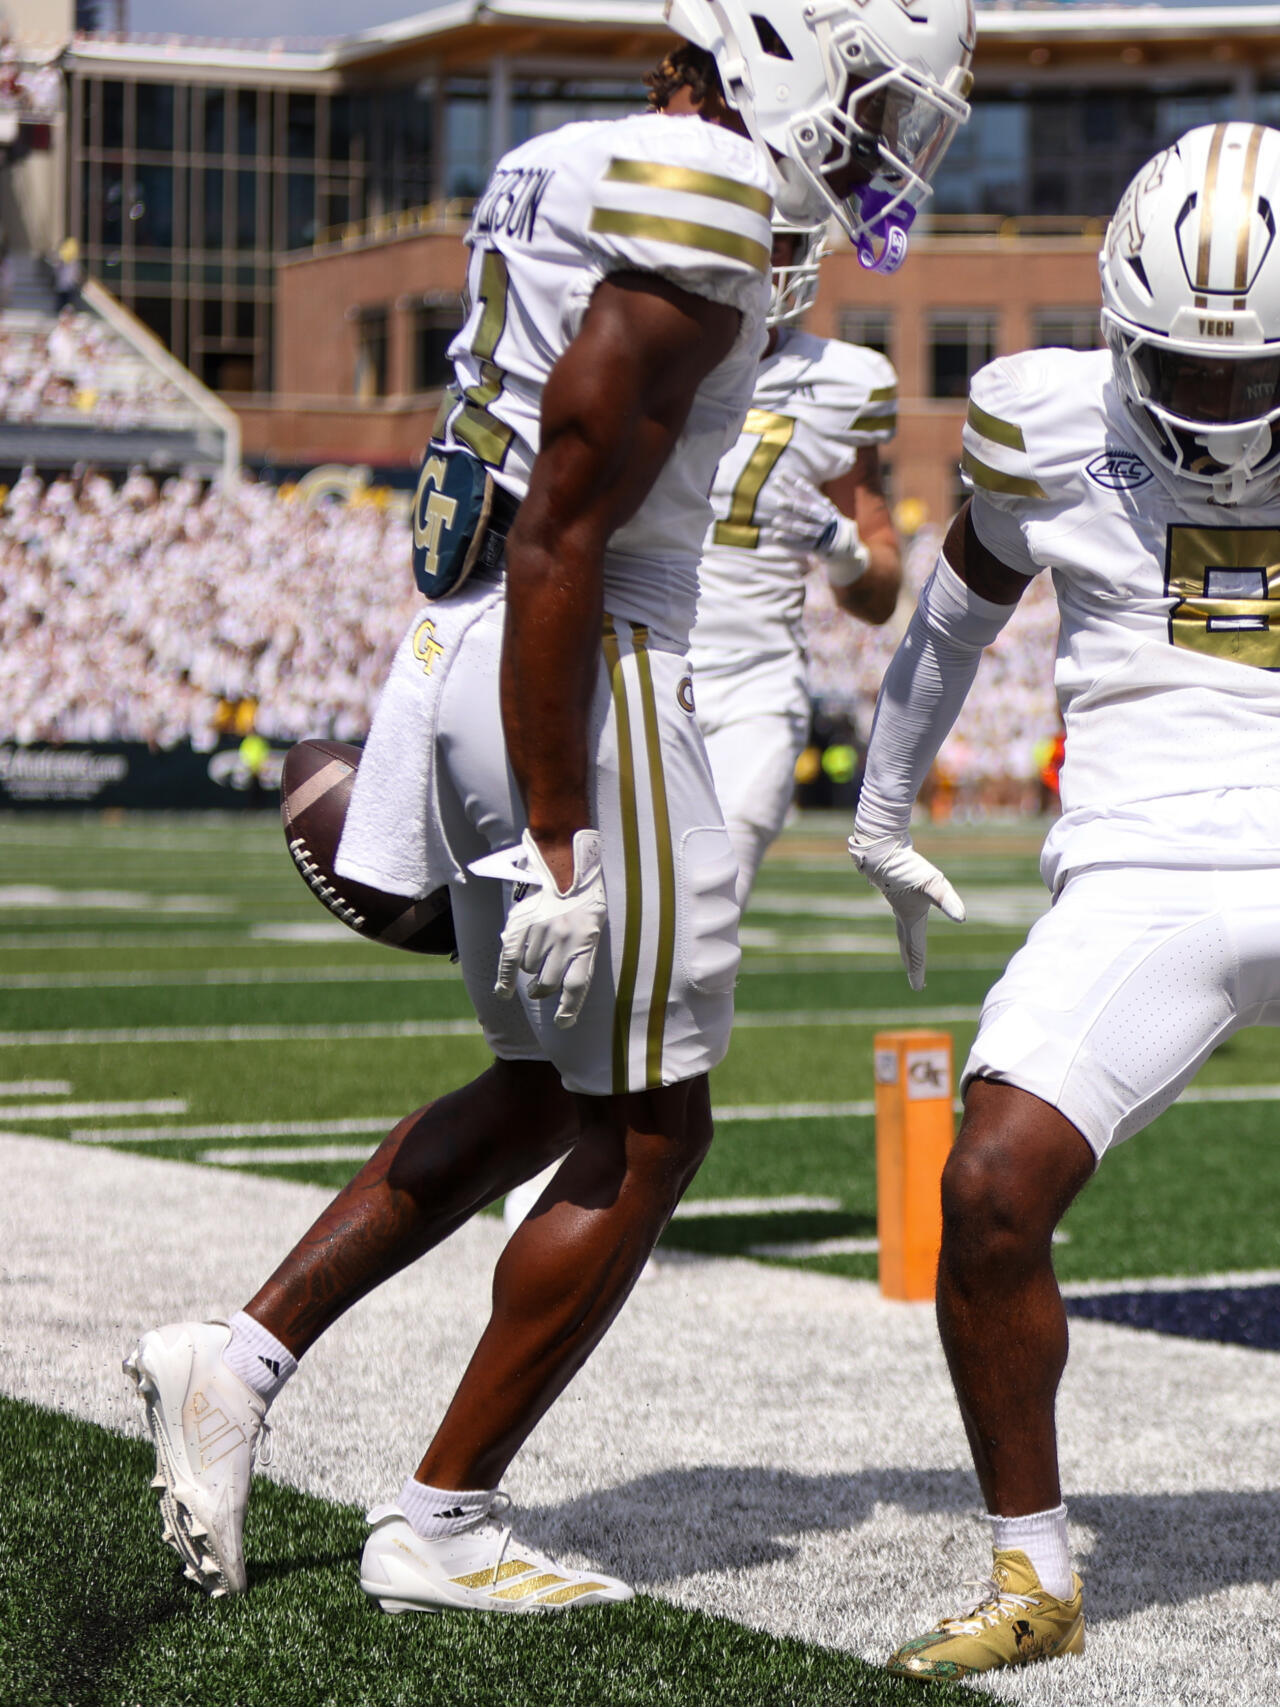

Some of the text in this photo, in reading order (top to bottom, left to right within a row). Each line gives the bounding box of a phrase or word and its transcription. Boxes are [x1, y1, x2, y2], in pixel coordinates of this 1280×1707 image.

[1198, 318, 1234, 337] TECH
[1097, 458, 1145, 478] ACC
[412, 618, 445, 677] GT
